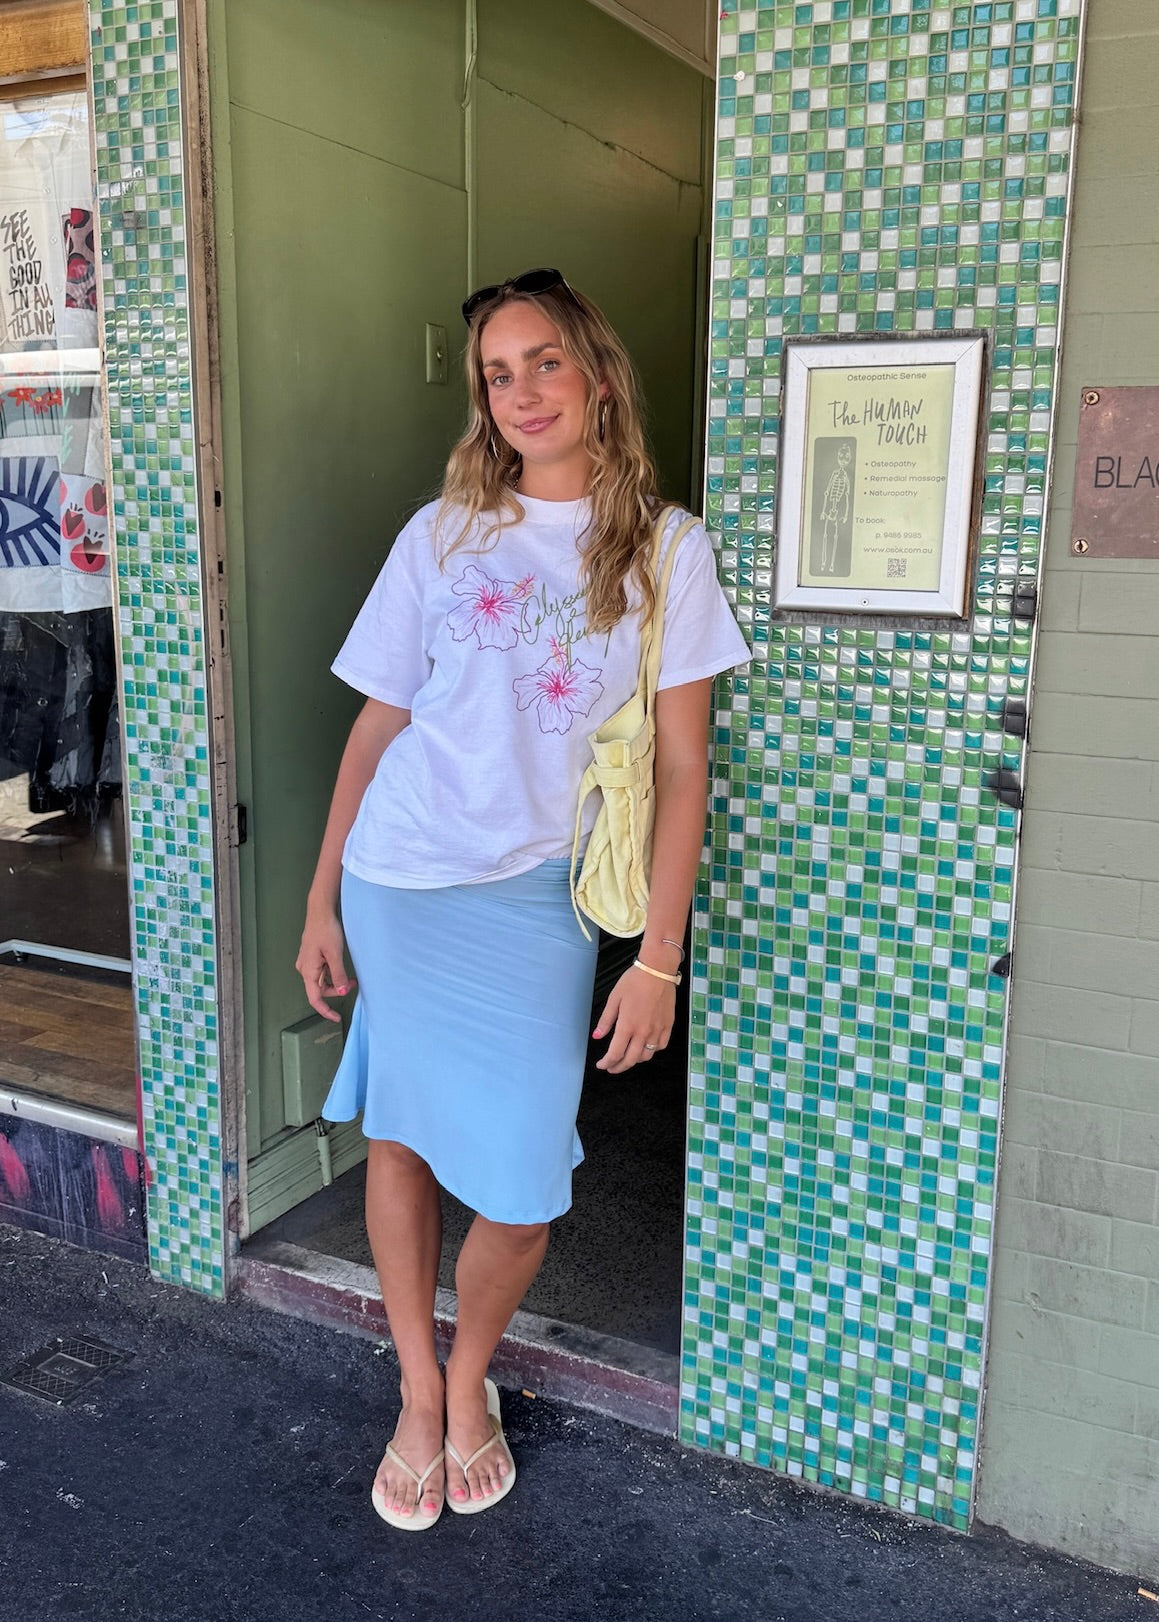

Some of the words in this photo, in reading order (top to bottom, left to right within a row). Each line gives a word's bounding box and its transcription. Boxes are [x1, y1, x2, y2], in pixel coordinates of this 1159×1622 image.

[0, 209, 31, 244] SEE
[3, 234, 37, 264] THE
[9, 260, 42, 290] GOOD
[8, 286, 29, 316] IN
[8, 308, 56, 340] THING
[847, 373, 898, 382] Osteopathic
[899, 372, 927, 380] Sense
[828, 400, 860, 428] The
[863, 397, 923, 426] HUMAN
[877, 422, 928, 446] TOUCH
[870, 460, 917, 469] Osteopathy
[870, 474, 908, 483] Remedial
[909, 475, 946, 483] massage
[1094, 455, 1159, 489] BLA
[869, 489, 918, 497] Naturopathy
[855, 516, 865, 525] To
